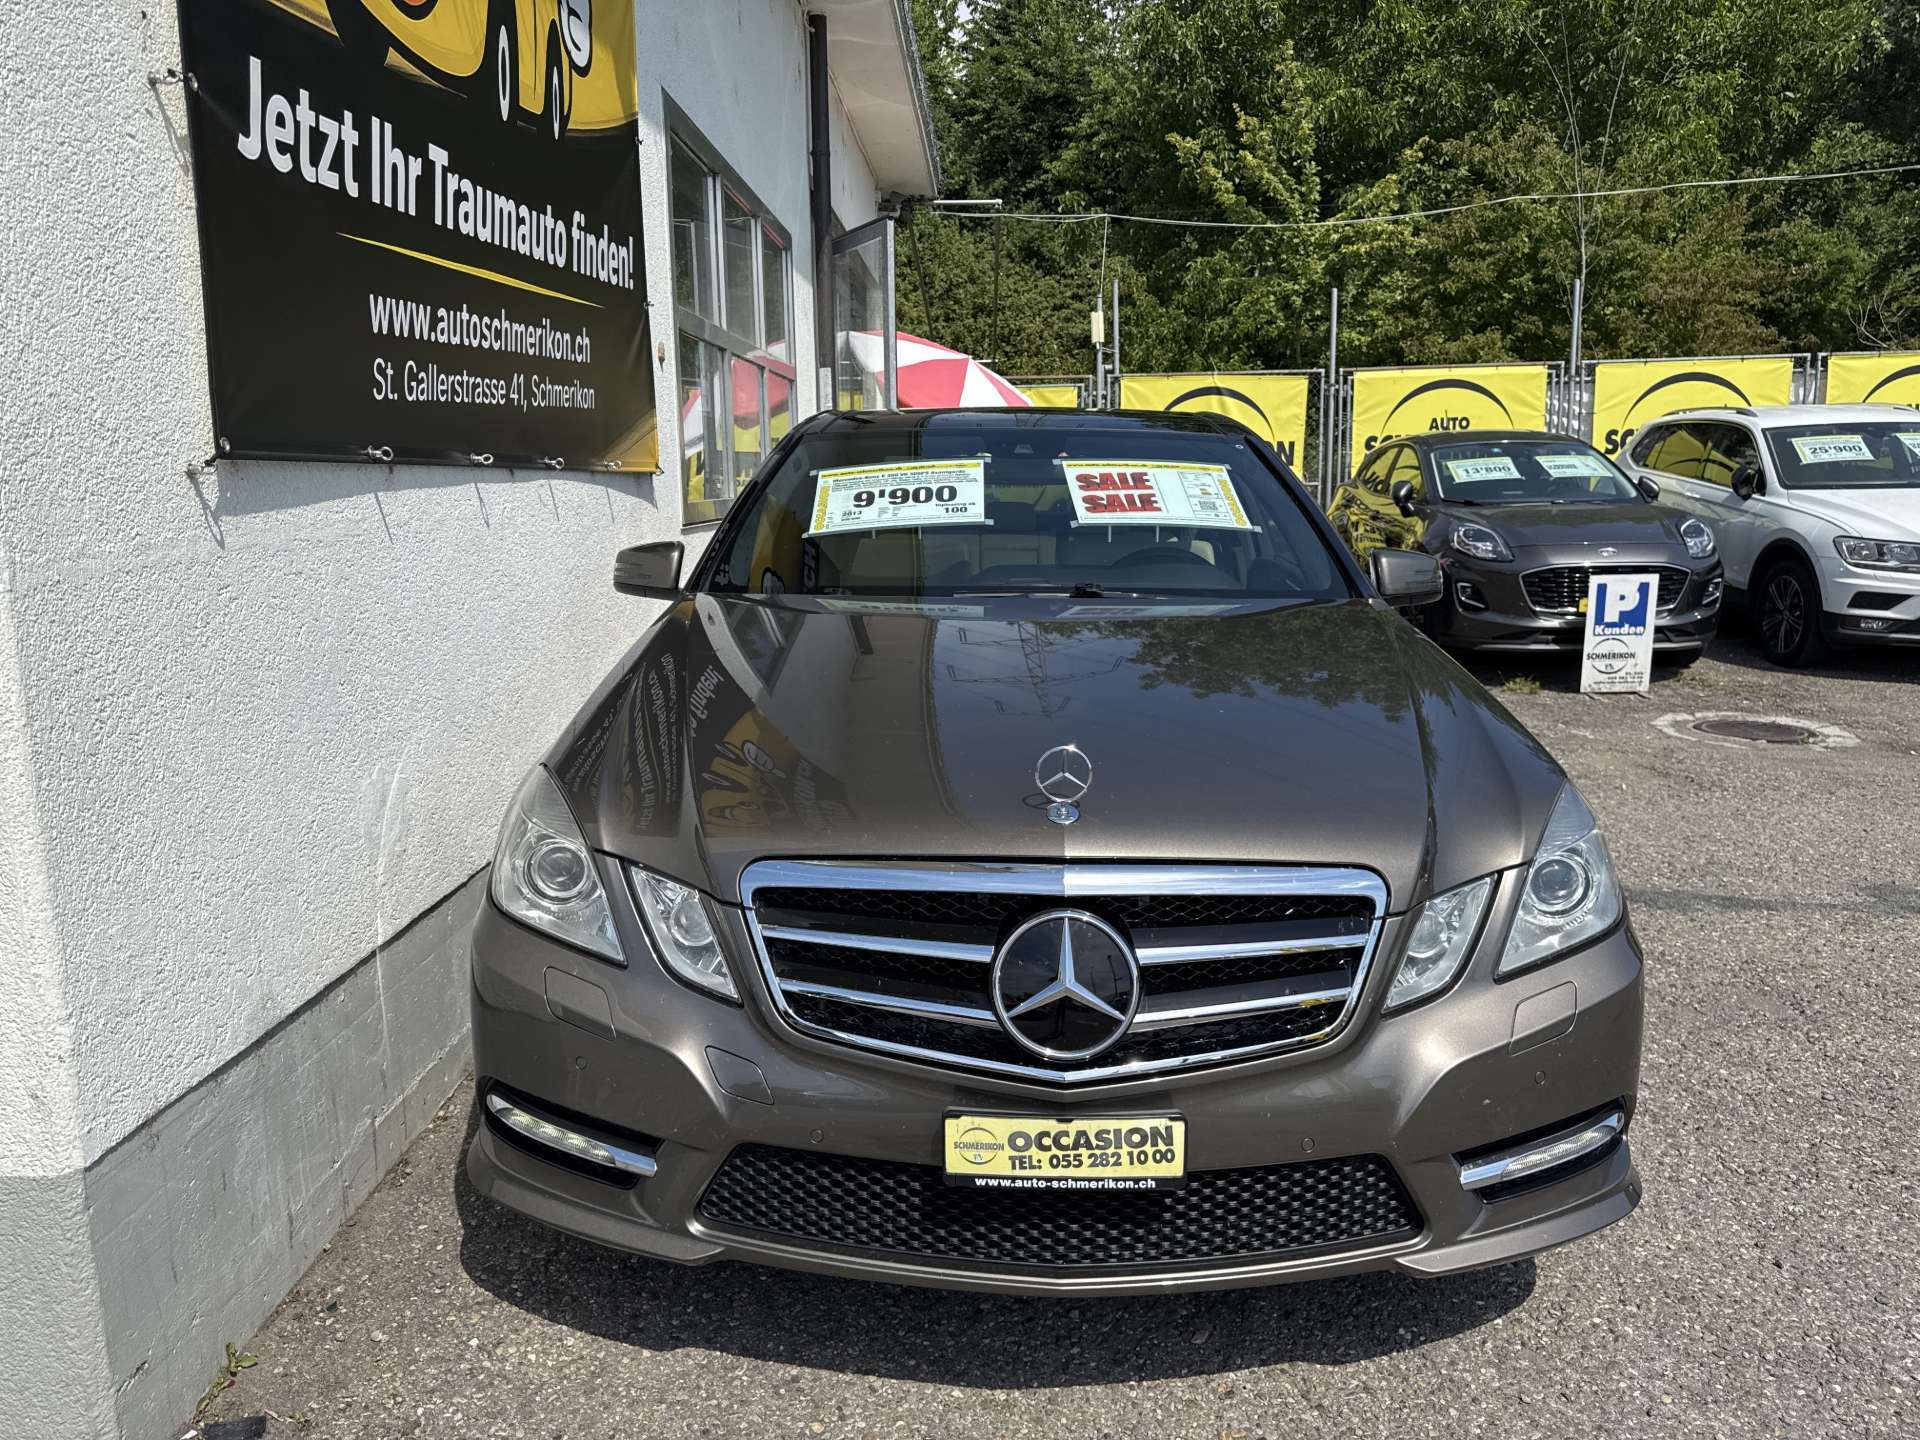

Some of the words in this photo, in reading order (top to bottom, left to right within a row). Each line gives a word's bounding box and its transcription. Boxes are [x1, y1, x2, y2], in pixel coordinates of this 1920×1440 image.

[238, 55, 359, 198] Jetzt
[371, 116, 422, 216] Ihr
[428, 142, 567, 268] Traumauto
[572, 211, 634, 290] finden!
[369, 294, 591, 363] www.autoschmerikon.ch
[373, 358, 397, 401] St.
[404, 360, 506, 405] Gallerstrasse
[510, 378, 527, 412] 41,
[531, 380, 595, 410] Schmerikon
[1429, 416, 1470, 431] AUTO
[1808, 444, 1862, 454] 25'900
[1462, 465, 1511, 475] 13'800
[1075, 472, 1153, 491] SALE
[853, 485, 957, 508] 9'900
[1081, 493, 1162, 513] SALE
[1603, 580, 1641, 622] P
[1595, 623, 1645, 635] Kunden
[1586, 651, 1636, 660] SCHMERIKON
[953, 1140, 1005, 1151] SCHMERIKON
[1007, 1125, 1174, 1153] OCCASION
[1008, 1154, 1042, 1170] TEL:
[1049, 1152, 1084, 1169] 055
[1087, 1151, 1122, 1168] 282
[1127, 1149, 1149, 1166] 10
[1152, 1148, 1175, 1164] 00
[974, 1176, 1156, 1189] www.auto-schmerikon.ch
